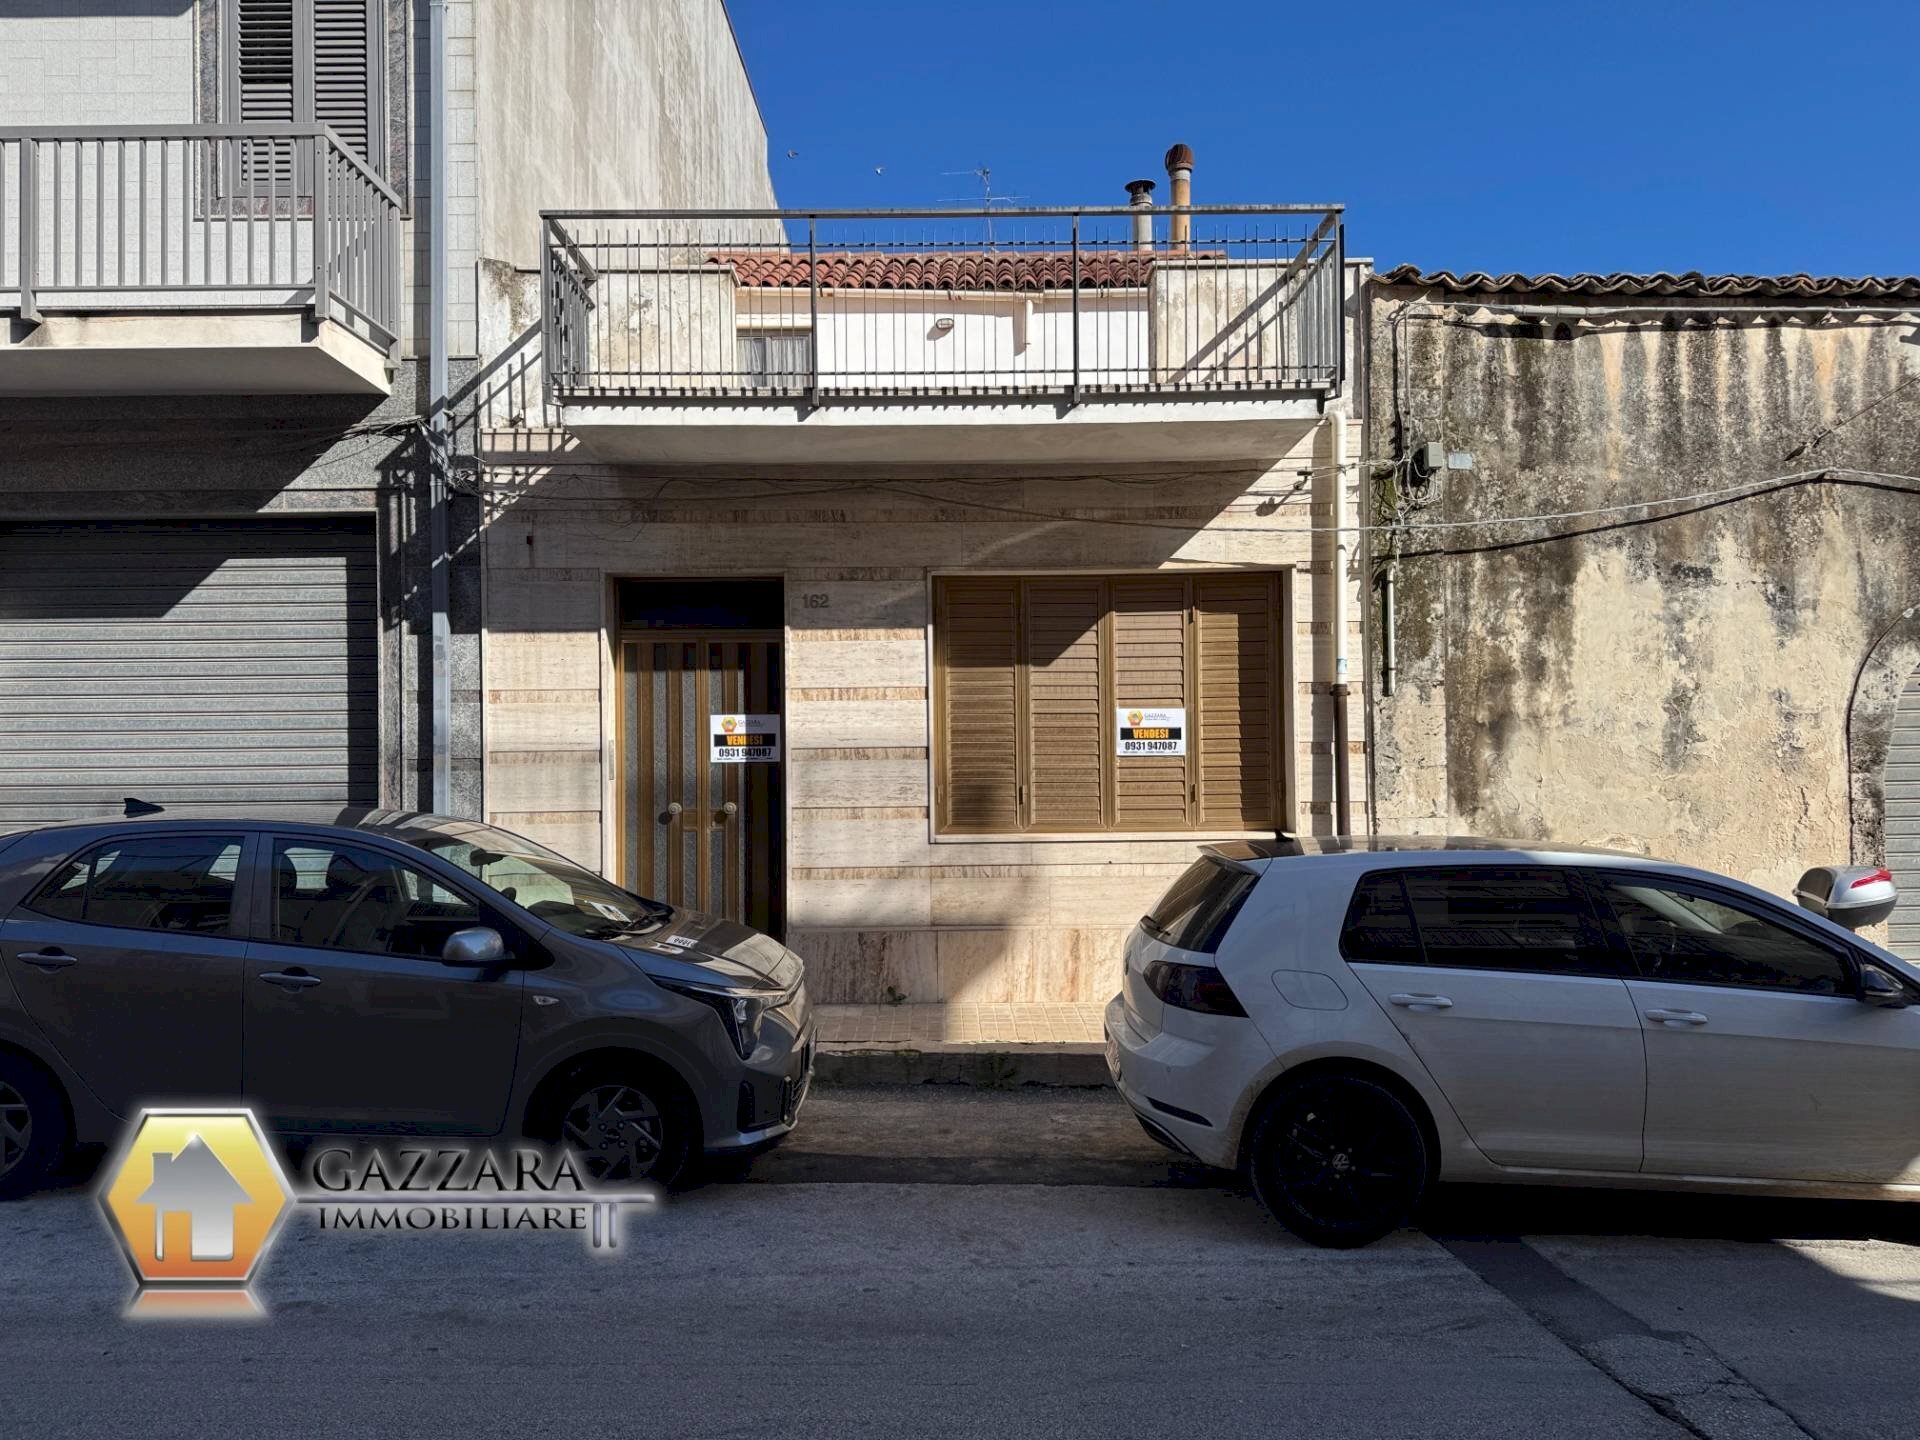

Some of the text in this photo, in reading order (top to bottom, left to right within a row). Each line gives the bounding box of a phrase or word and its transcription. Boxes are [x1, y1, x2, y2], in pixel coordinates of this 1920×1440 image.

[802, 593, 830, 609] 162
[1133, 728, 1169, 739] VENDESI
[727, 735, 763, 745] VENDESI
[1125, 741, 1178, 751] 0931 947087
[718, 748, 772, 757] 0931 947087
